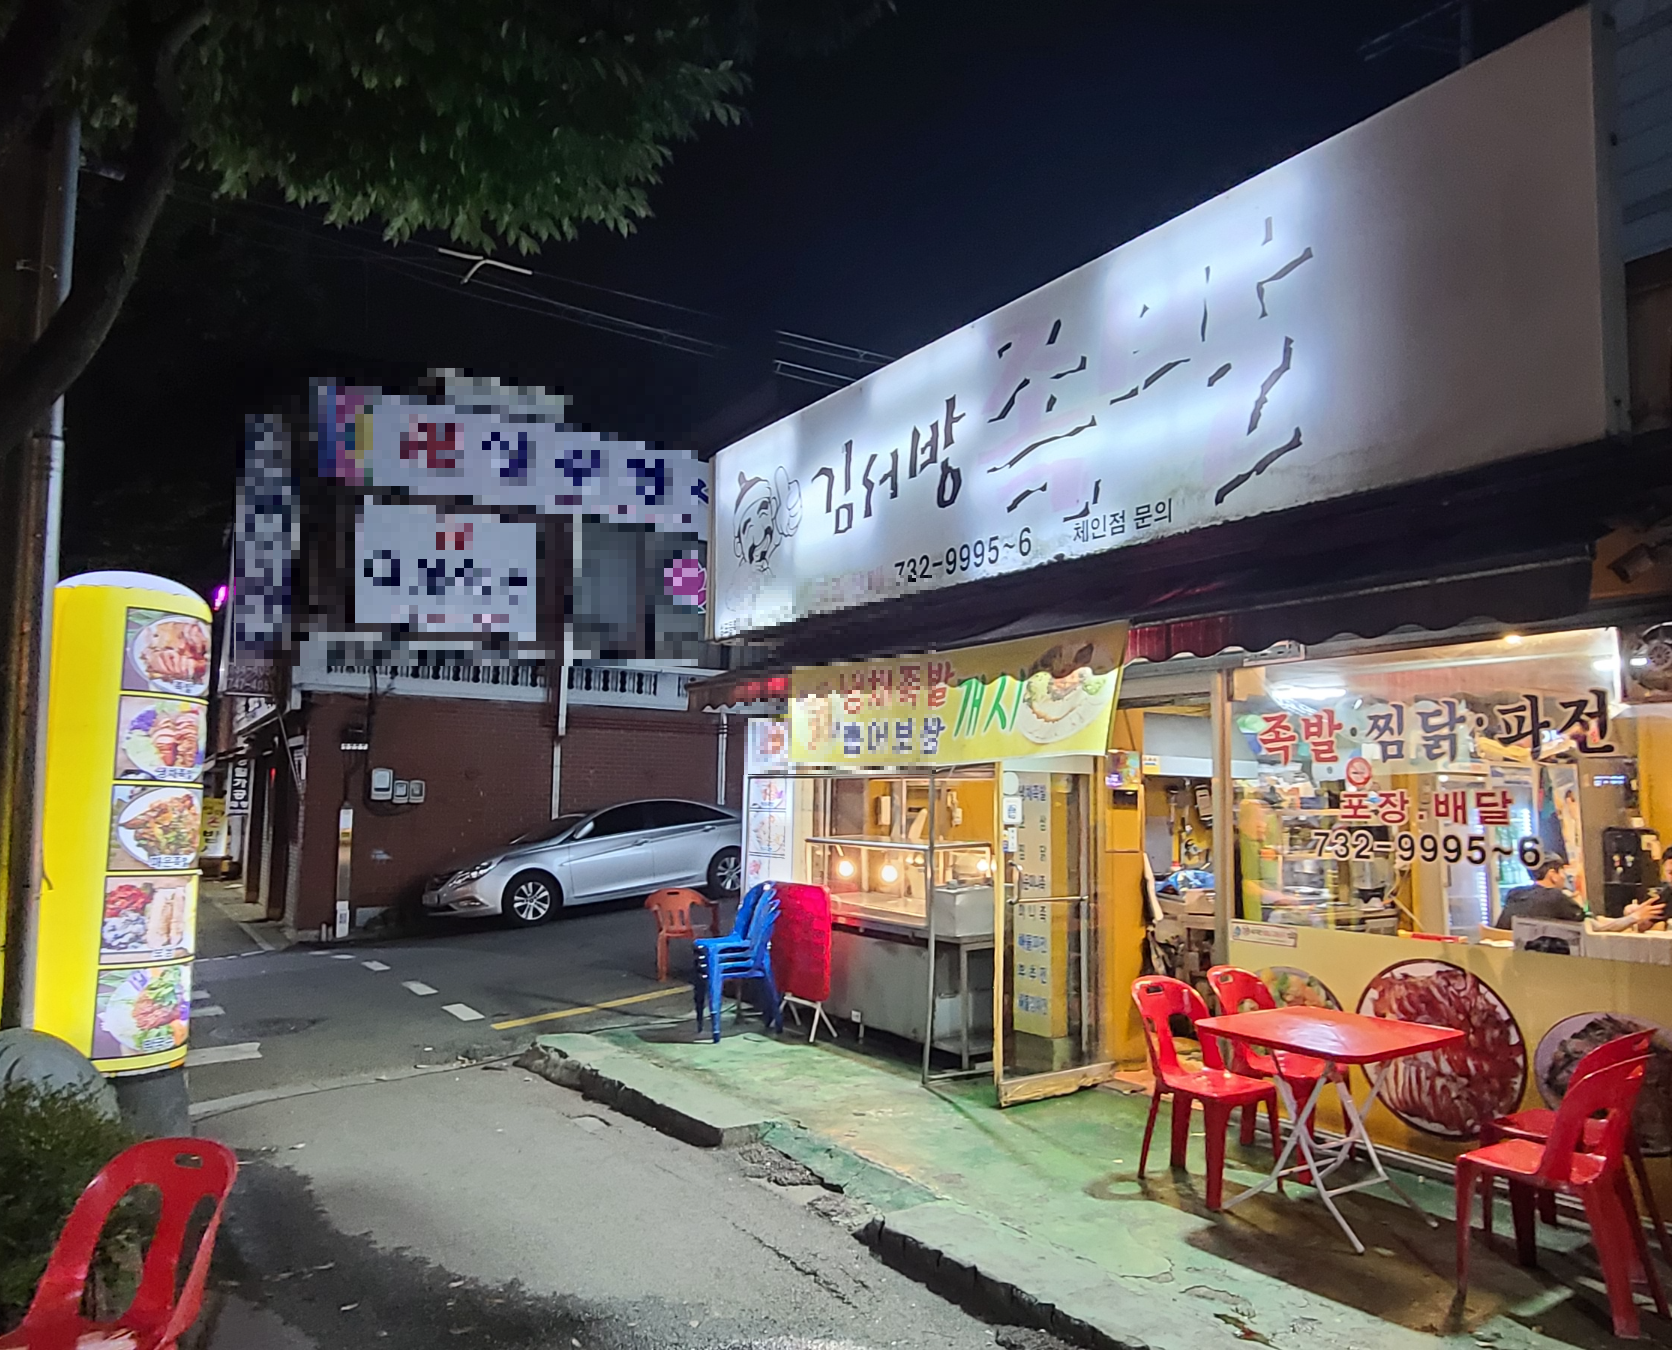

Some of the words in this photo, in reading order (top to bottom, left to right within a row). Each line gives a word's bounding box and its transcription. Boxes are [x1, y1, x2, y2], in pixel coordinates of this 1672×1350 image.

[811, 394, 966, 535] 김서방
[1073, 509, 1126, 543] 체인점
[1133, 498, 1172, 530] 문의
[894, 526, 1033, 582] 732-9995~6
[954, 669, 1026, 737] 개시
[1258, 708, 1344, 766] 족발
[1496, 689, 1615, 761] 파전
[1340, 791, 1410, 824] 포장
[1434, 790, 1514, 826] 배달
[1314, 831, 1541, 868] 732-9995~6
